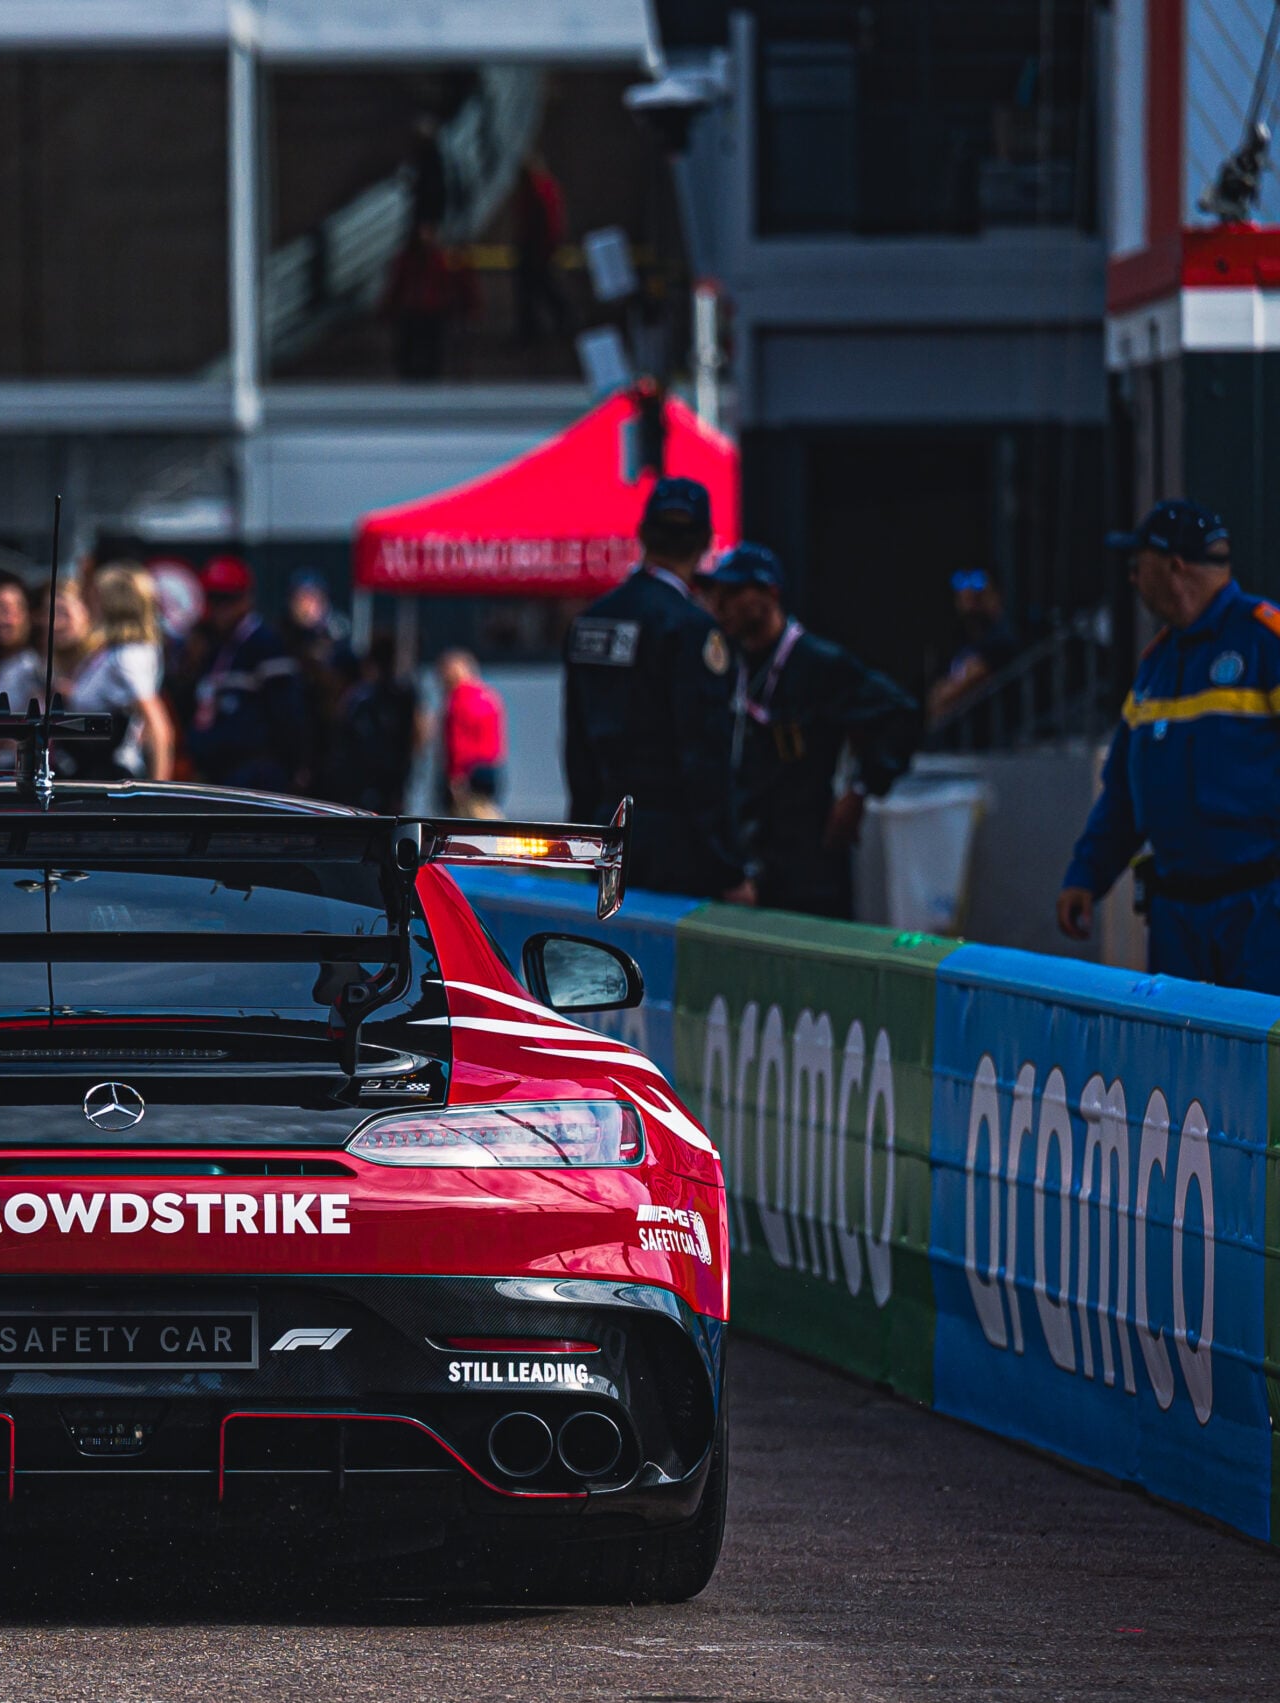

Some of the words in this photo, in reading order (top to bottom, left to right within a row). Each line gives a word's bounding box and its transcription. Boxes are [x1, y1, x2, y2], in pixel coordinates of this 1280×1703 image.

[704, 994, 894, 1308] aramco
[656, 1206, 690, 1228] AMG
[638, 1227, 681, 1253] SAFETY
[965, 1051, 1215, 1427] aramco
[0, 1326, 140, 1352] SAFETY
[159, 1326, 233, 1352] CAR
[448, 1361, 504, 1383] STILL
[508, 1362, 595, 1385] LEADING.
